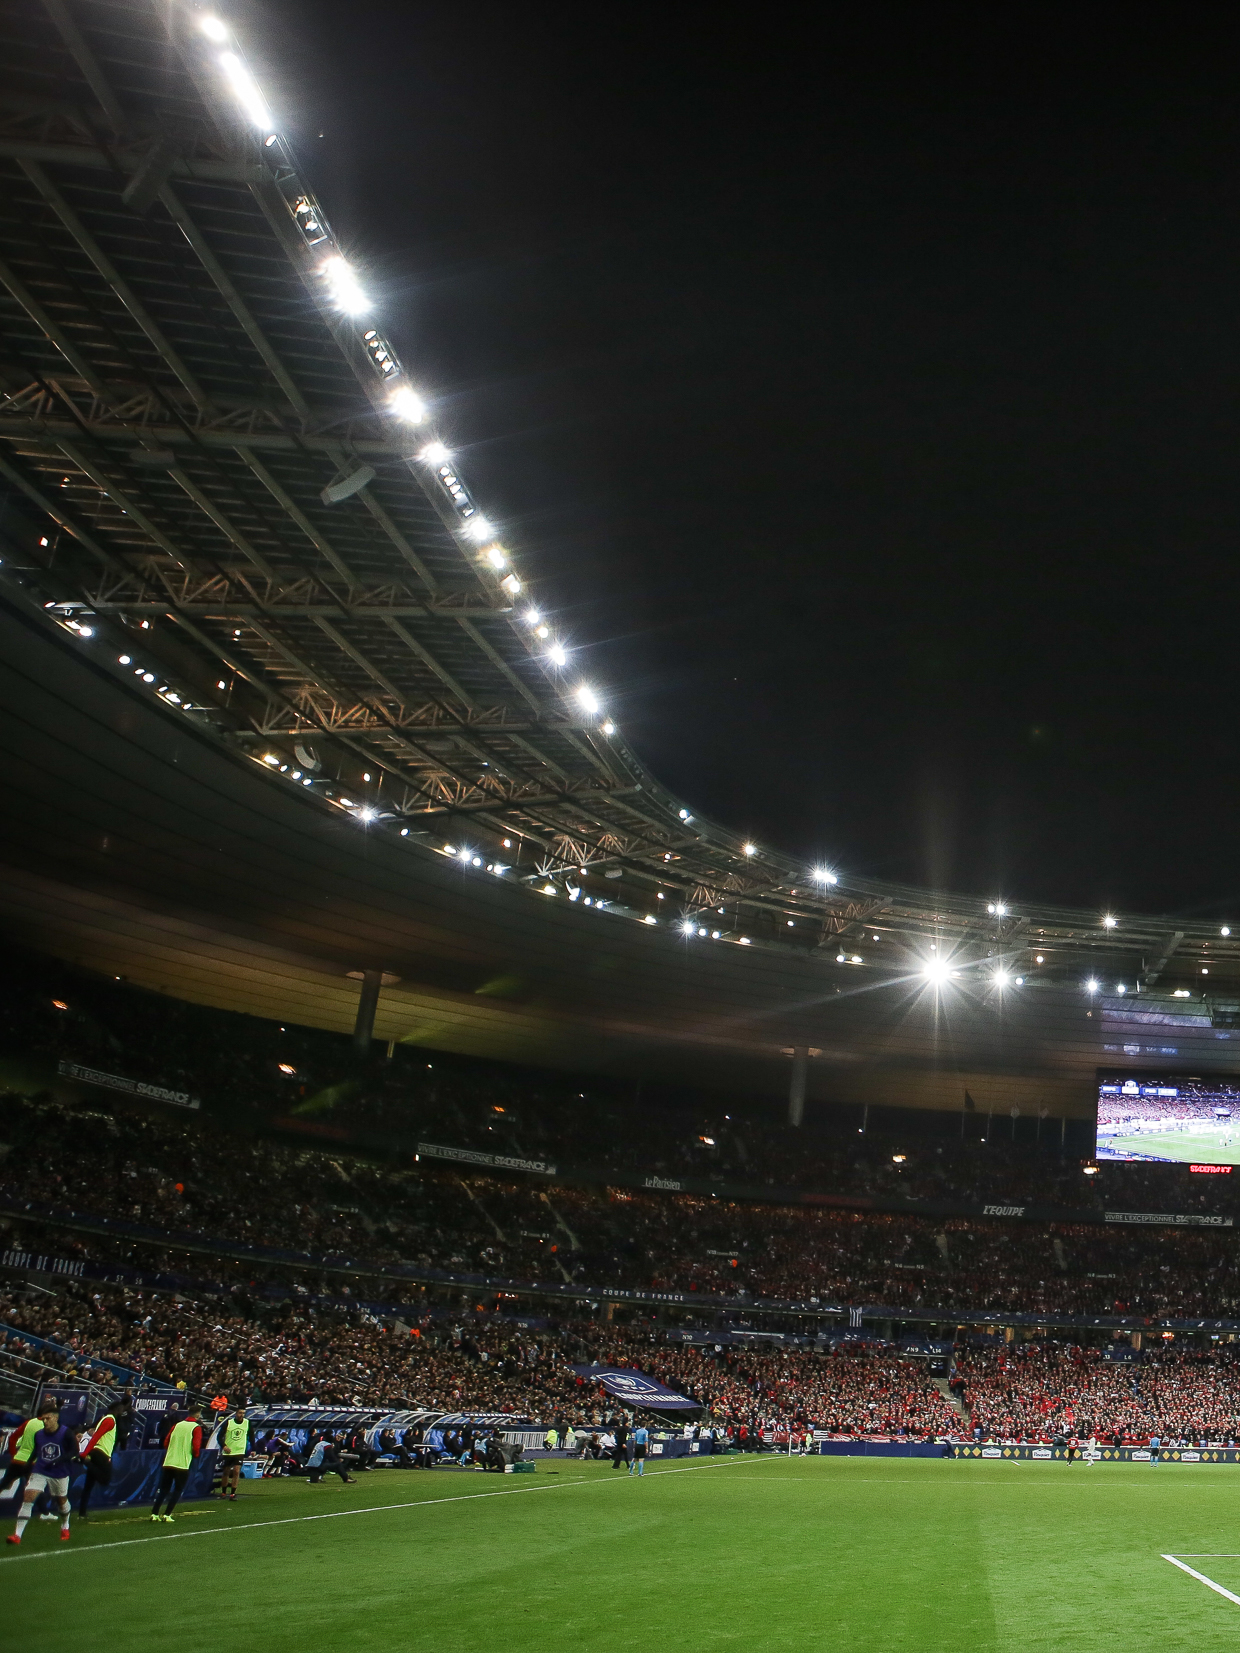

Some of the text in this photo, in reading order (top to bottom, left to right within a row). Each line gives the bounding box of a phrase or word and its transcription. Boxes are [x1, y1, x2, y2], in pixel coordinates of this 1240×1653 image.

[982, 1205, 1026, 1217] L'EQUIPE
[3, 1250, 85, 1277] COUPE DE FRANCE
[602, 1289, 630, 1298] COUPE
[651, 1292, 684, 1302] FRANCE
